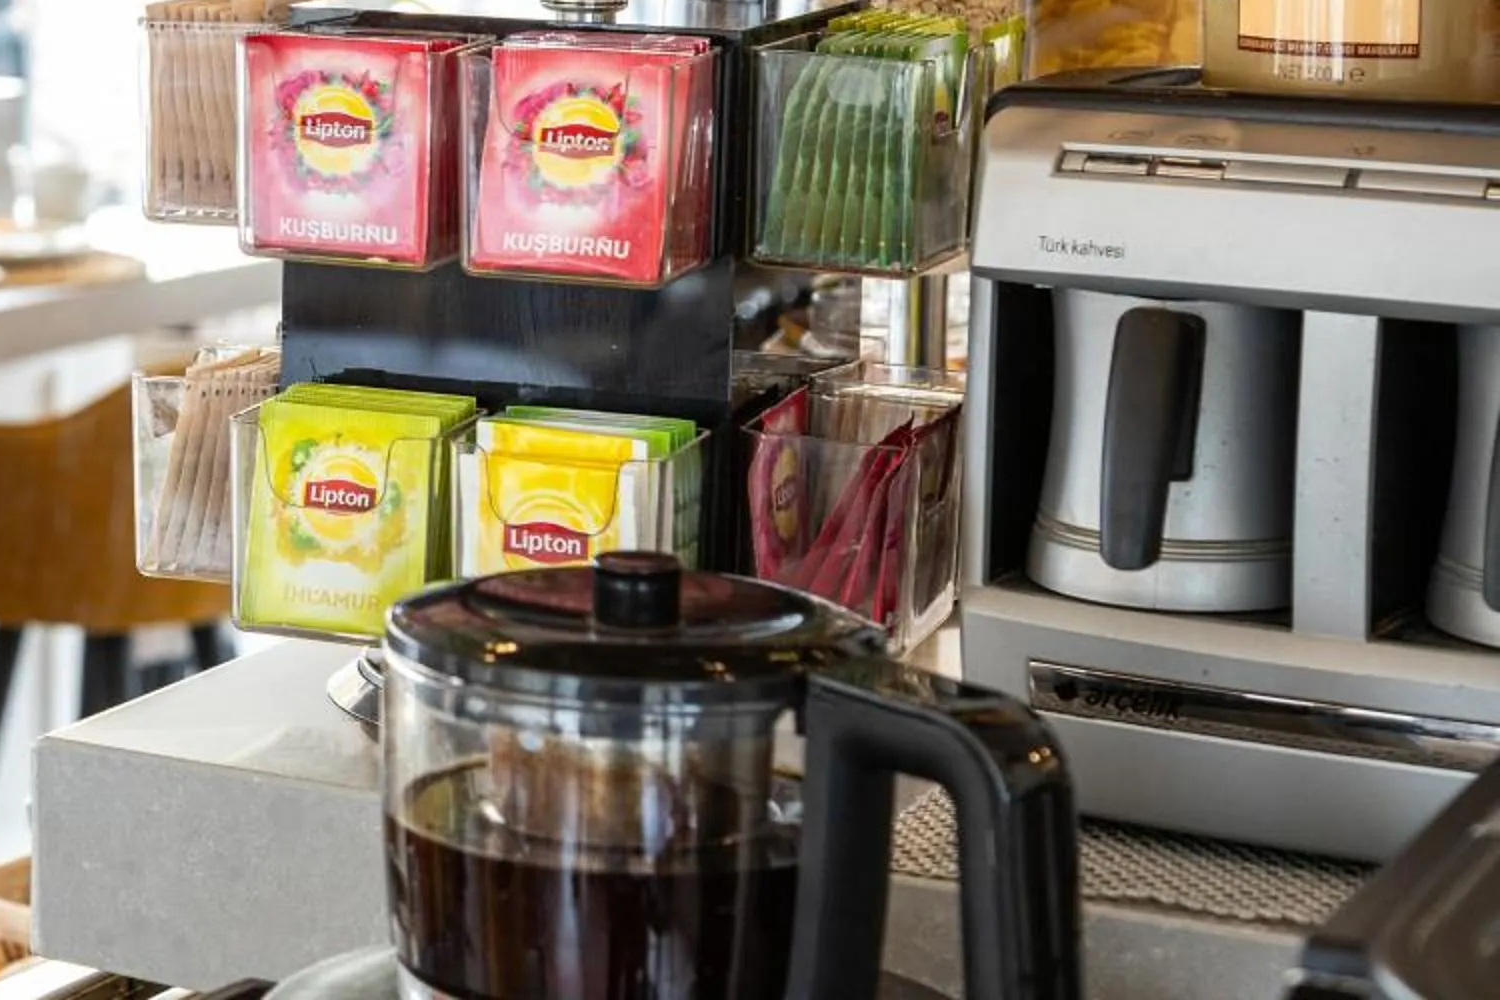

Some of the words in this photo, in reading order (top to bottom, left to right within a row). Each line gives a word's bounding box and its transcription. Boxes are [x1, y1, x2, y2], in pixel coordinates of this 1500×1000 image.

[305, 117, 366, 141] Lipton
[545, 130, 612, 153] Lipton
[279, 215, 398, 245] KUŞBURNU
[503, 231, 632, 260] KUŞBURNU
[310, 484, 370, 508] Lipton
[510, 528, 582, 555] Lipton
